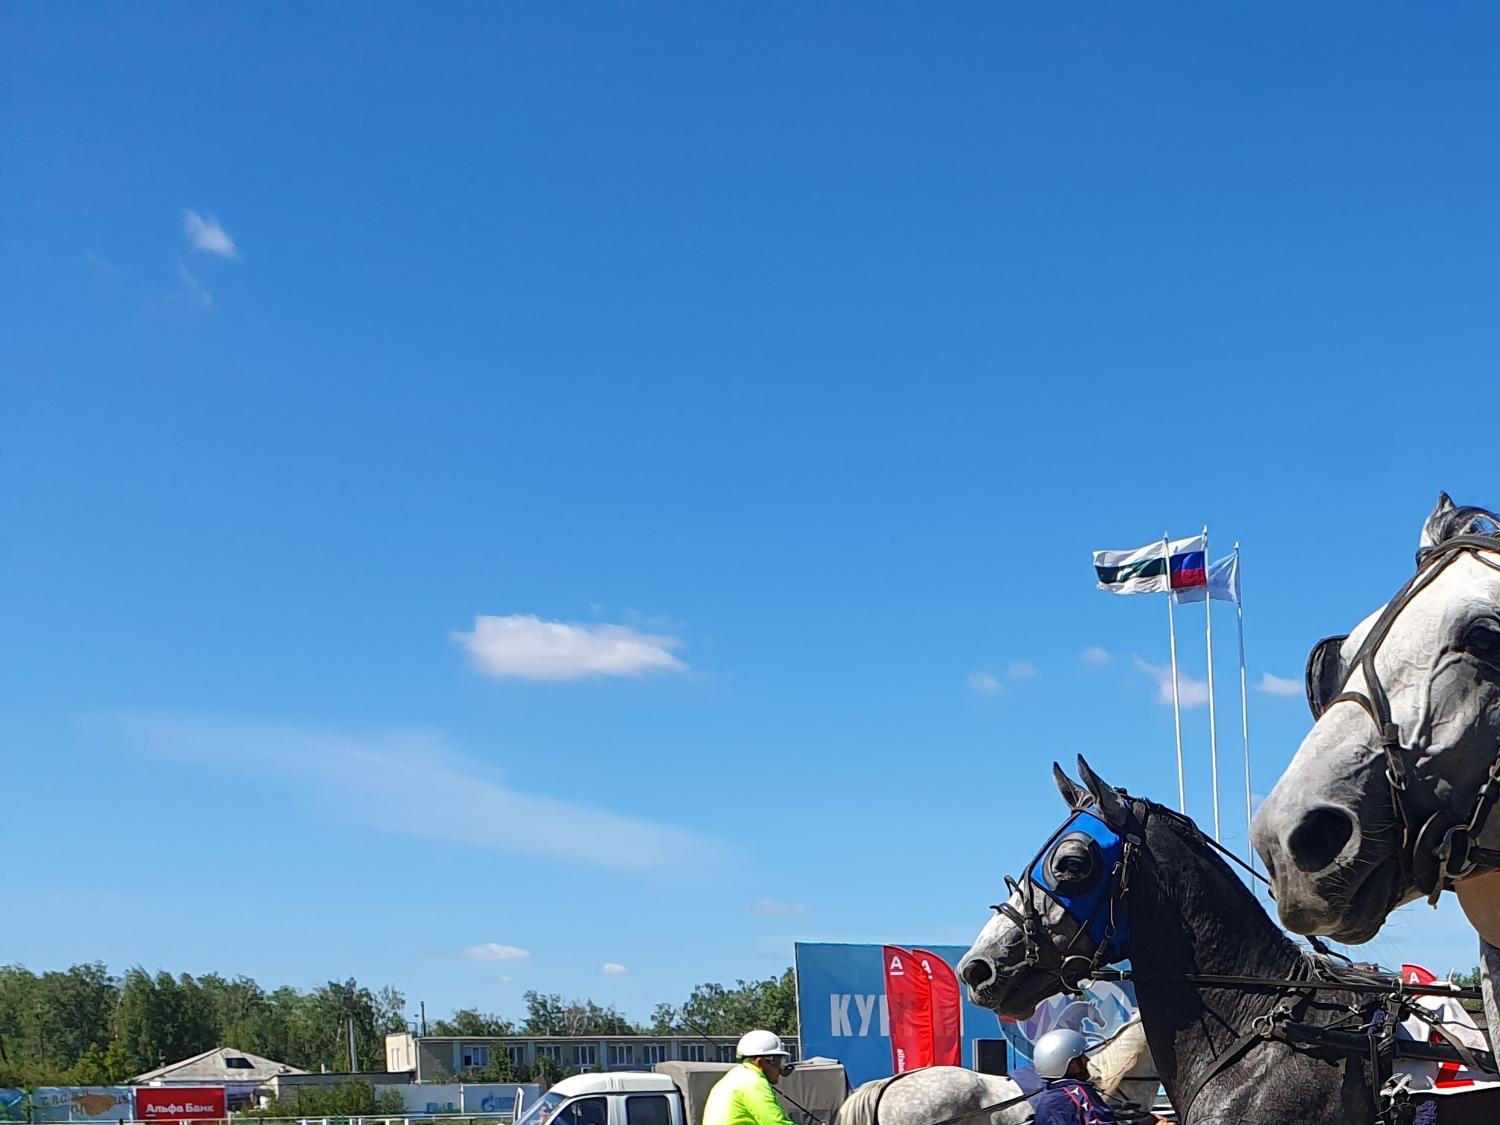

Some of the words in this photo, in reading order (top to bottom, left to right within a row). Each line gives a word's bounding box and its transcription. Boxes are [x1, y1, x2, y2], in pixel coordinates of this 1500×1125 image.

[889, 955, 904, 971] A
[1409, 971, 1421, 984] A
[145, 1103, 184, 1115] Альфа
[185, 1102, 214, 1113] Банк
